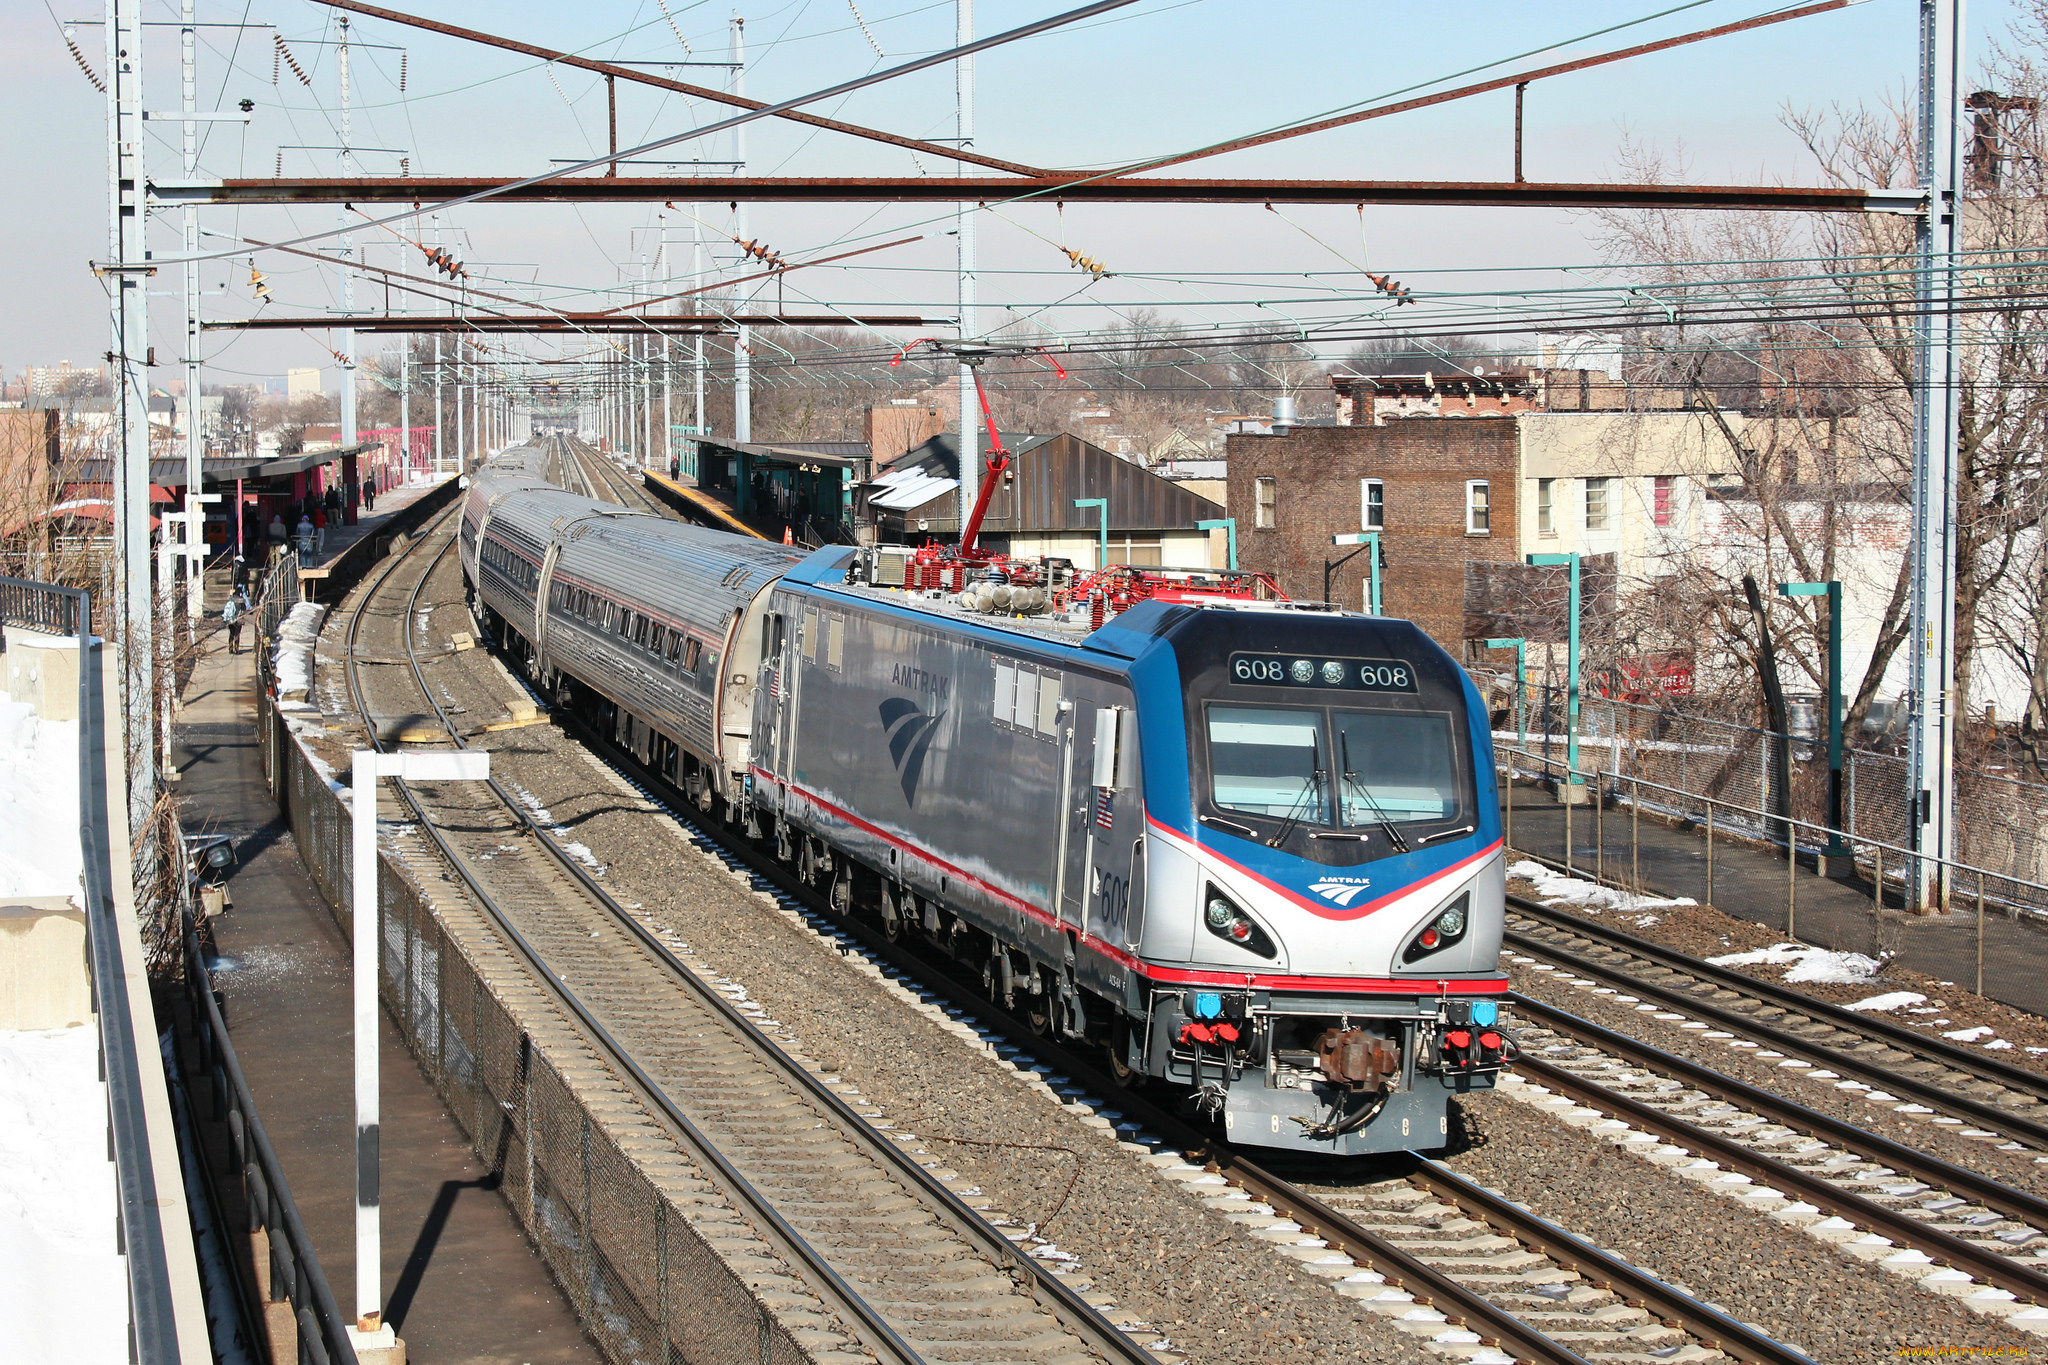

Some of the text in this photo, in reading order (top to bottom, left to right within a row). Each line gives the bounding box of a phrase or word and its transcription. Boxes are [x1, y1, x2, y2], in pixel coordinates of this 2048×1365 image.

[1235, 659, 1284, 681] 608
[1361, 666, 1409, 687] 608
[892, 663, 948, 700] AMTRAK
[1319, 876, 1370, 884] AMTRAK
